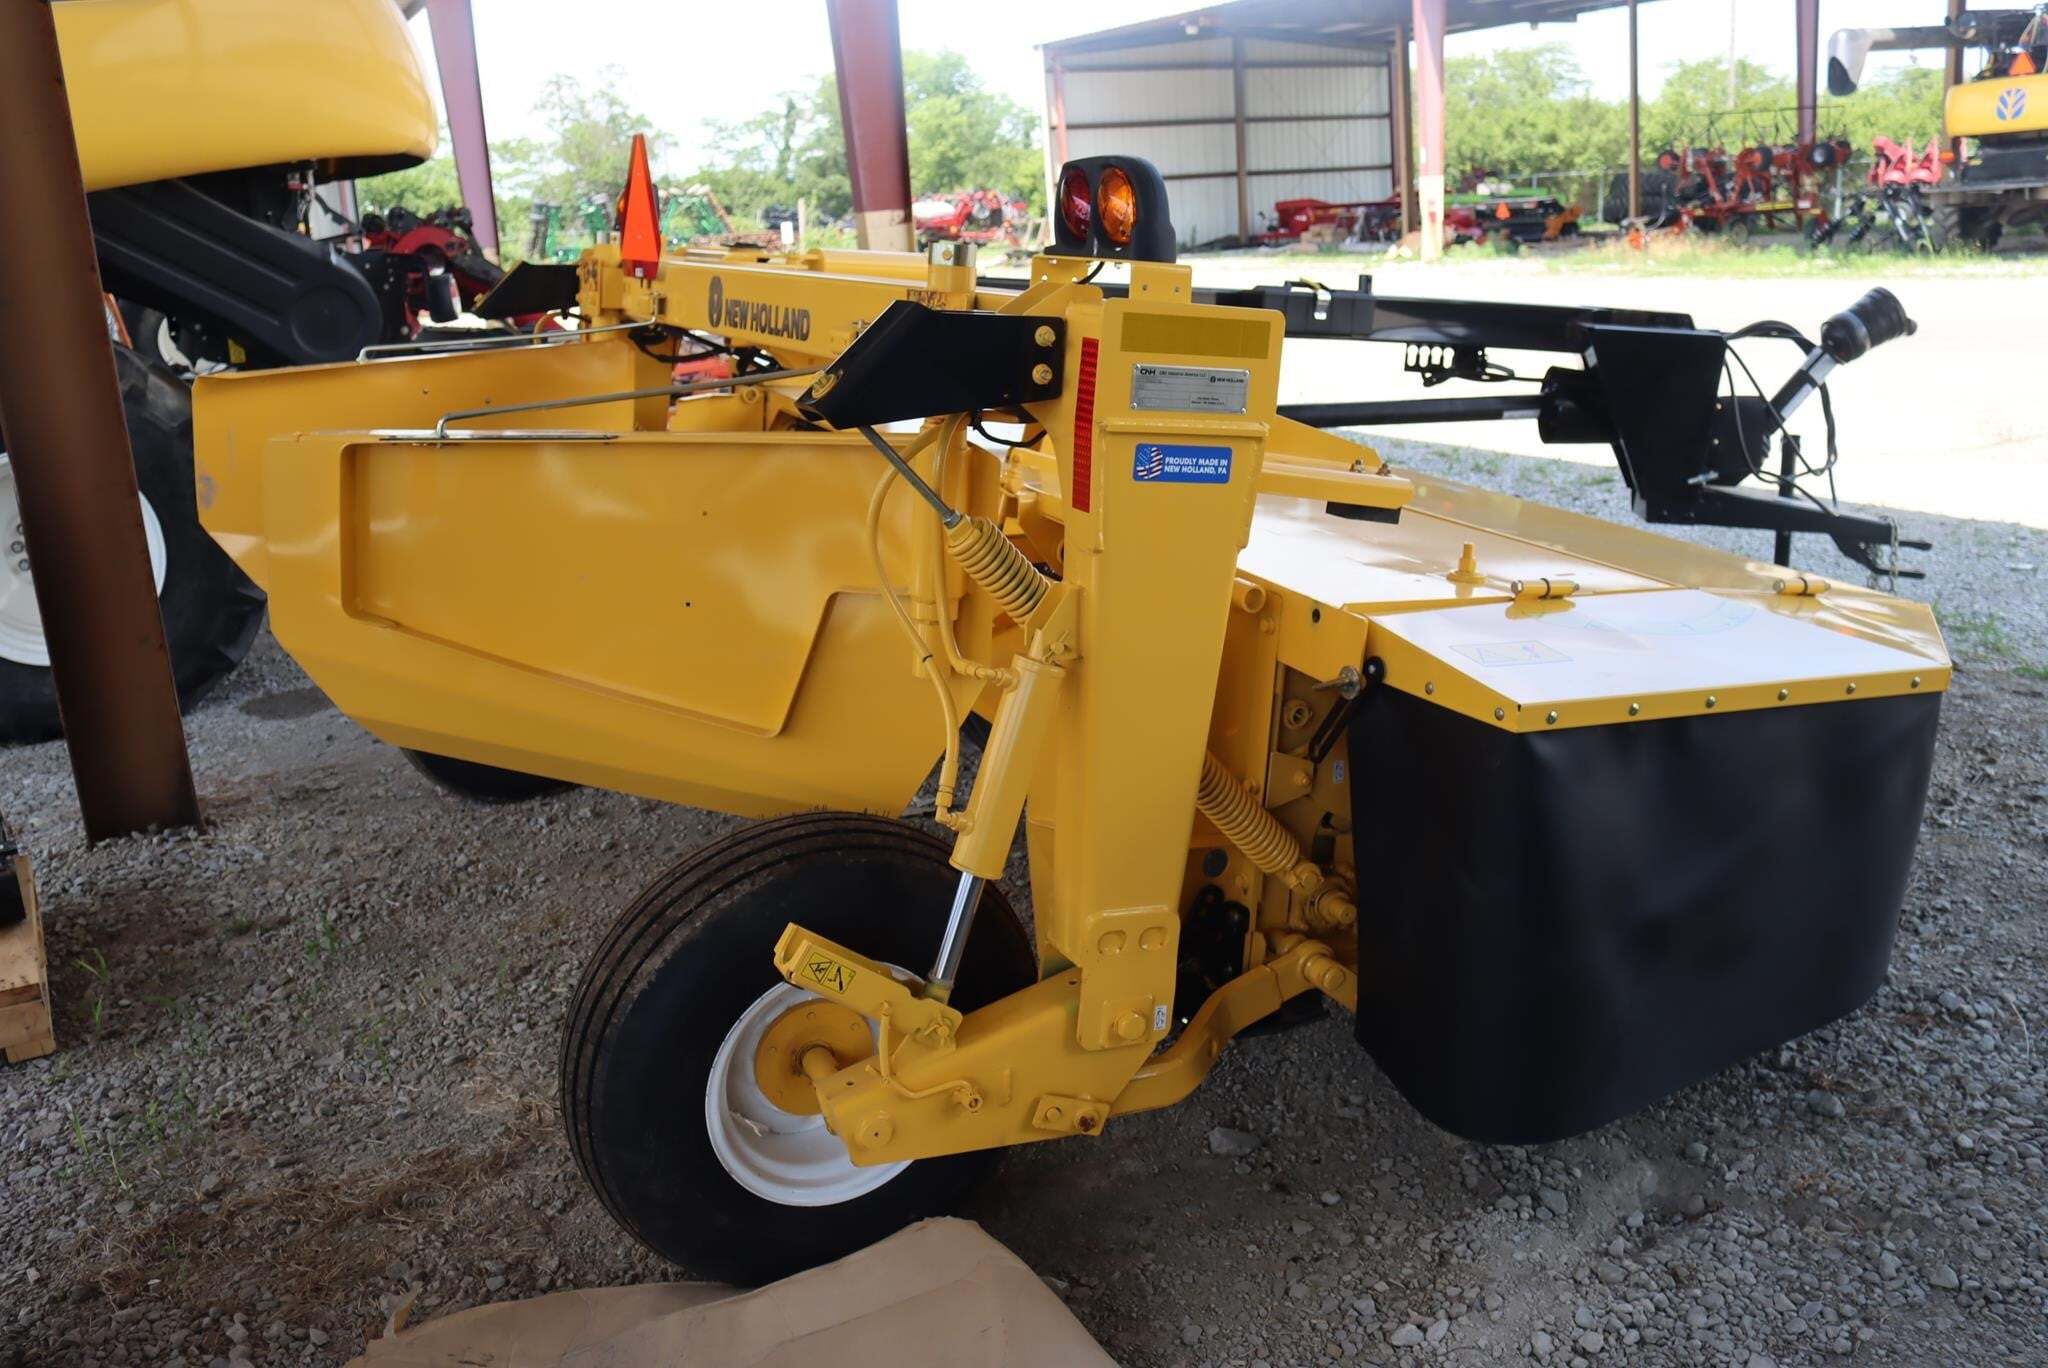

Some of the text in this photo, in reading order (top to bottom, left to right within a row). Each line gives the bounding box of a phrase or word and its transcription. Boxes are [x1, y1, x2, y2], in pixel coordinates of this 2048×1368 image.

[724, 298, 811, 342] NEW HOLLAND
[1140, 368, 1155, 376] CNH
[1165, 456, 1197, 466] PROUDLY
[1198, 458, 1219, 466] MADE
[1164, 465, 1227, 475] NEW HOLLAND, PA
